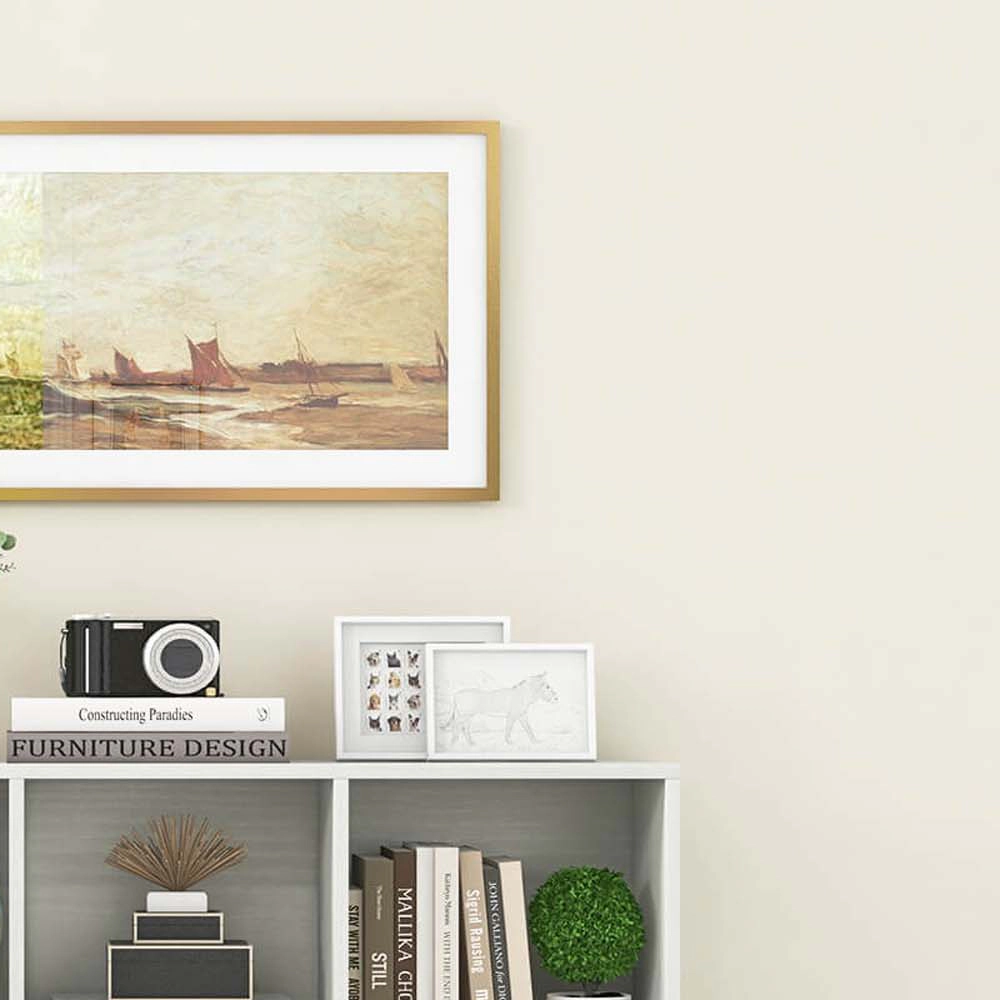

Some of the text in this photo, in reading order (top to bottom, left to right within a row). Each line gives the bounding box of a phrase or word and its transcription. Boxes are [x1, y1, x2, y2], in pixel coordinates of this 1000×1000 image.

[78, 707, 193, 724] Constructing Paradies
[11, 738, 287, 758] FURNITURE DESIGN
[488, 880, 499, 911] JOHN
[348, 904, 360, 927] STAY
[397, 887, 413, 962] MALLIKA
[348, 929, 360, 954] WITH
[466, 889, 485, 974] Sigrid Rausing
[491, 912, 505, 969] GALLIANO
[348, 956, 360, 971] ME
[371, 952, 388, 990] STILL
